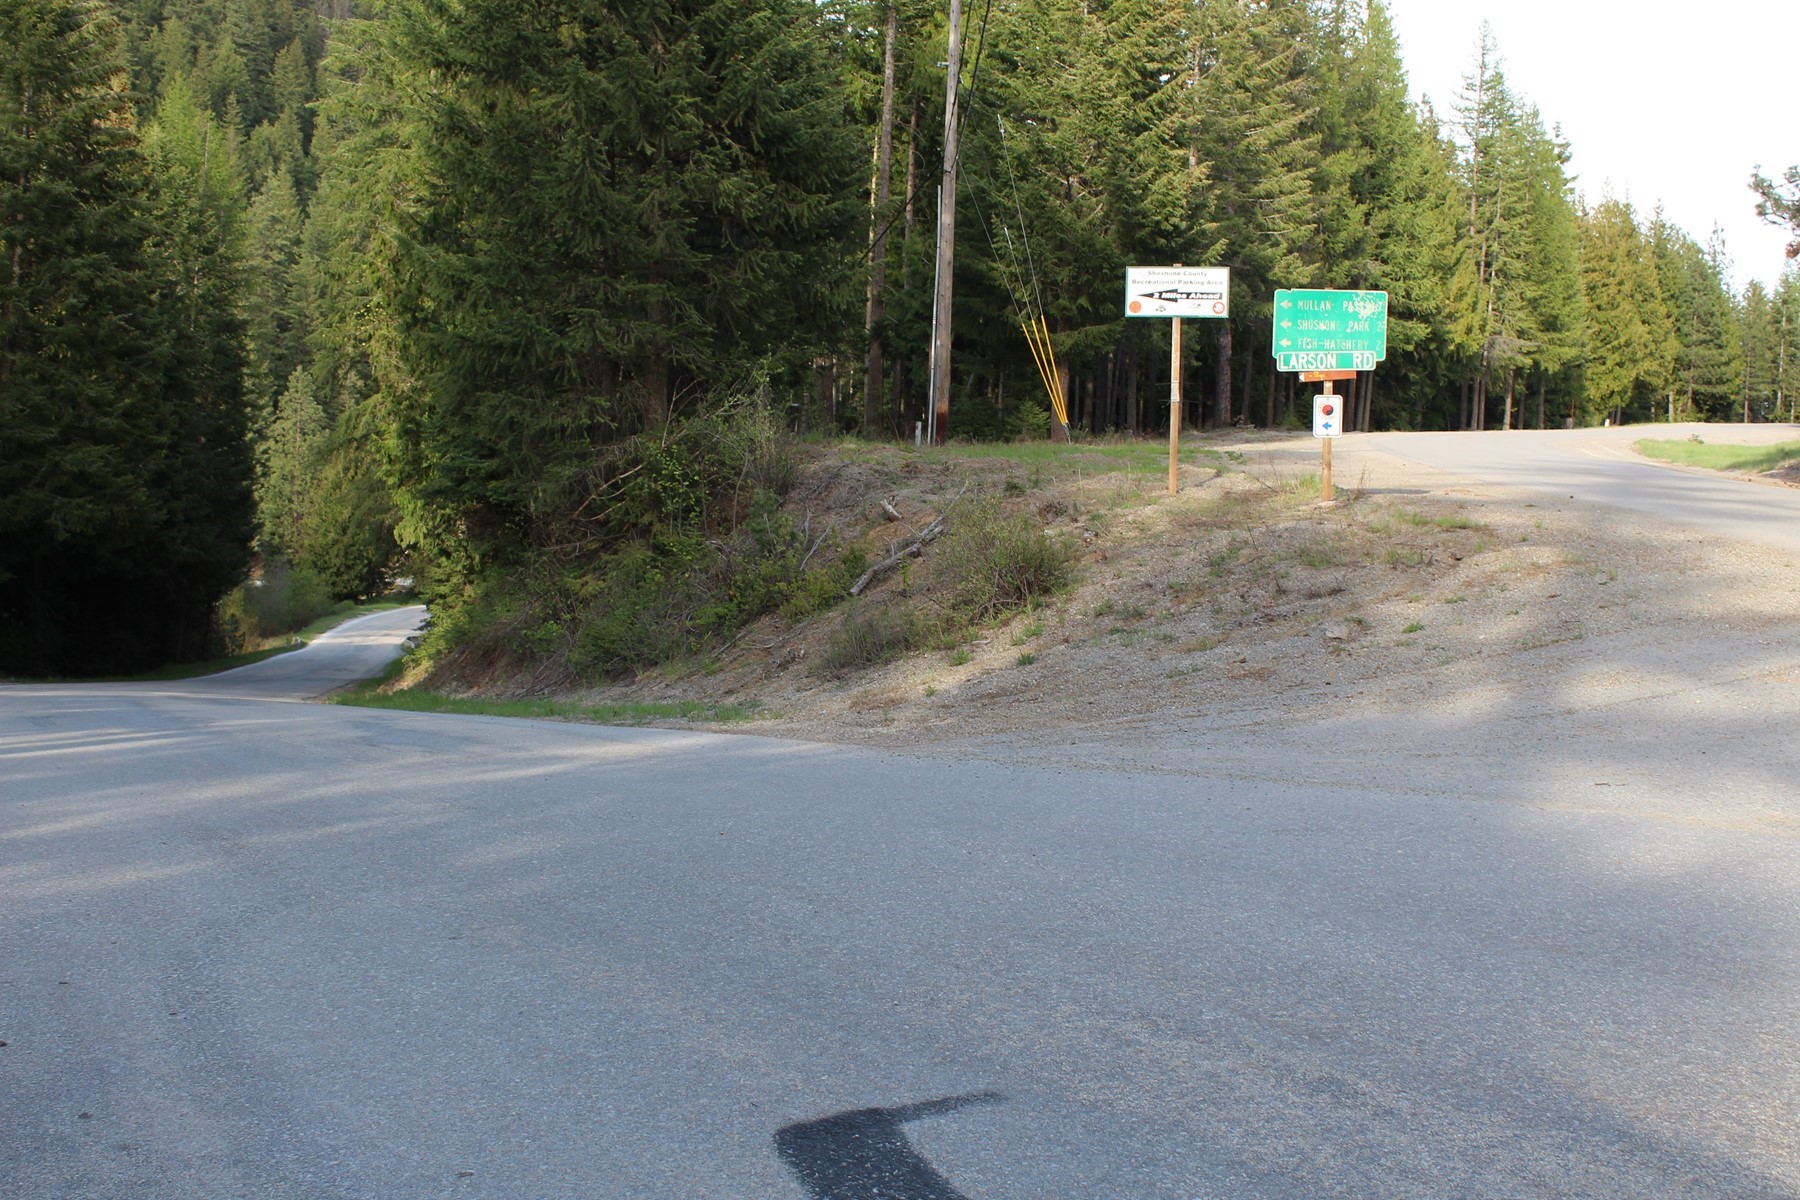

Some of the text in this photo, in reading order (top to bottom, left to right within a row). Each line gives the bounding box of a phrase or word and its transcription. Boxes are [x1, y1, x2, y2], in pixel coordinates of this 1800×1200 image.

[1297, 300, 1332, 311] MULLAN
[1297, 319, 1341, 331] SHOSHONE
[1348, 321, 1370, 332] PARK
[1280, 352, 1373, 369] LARSON RD
